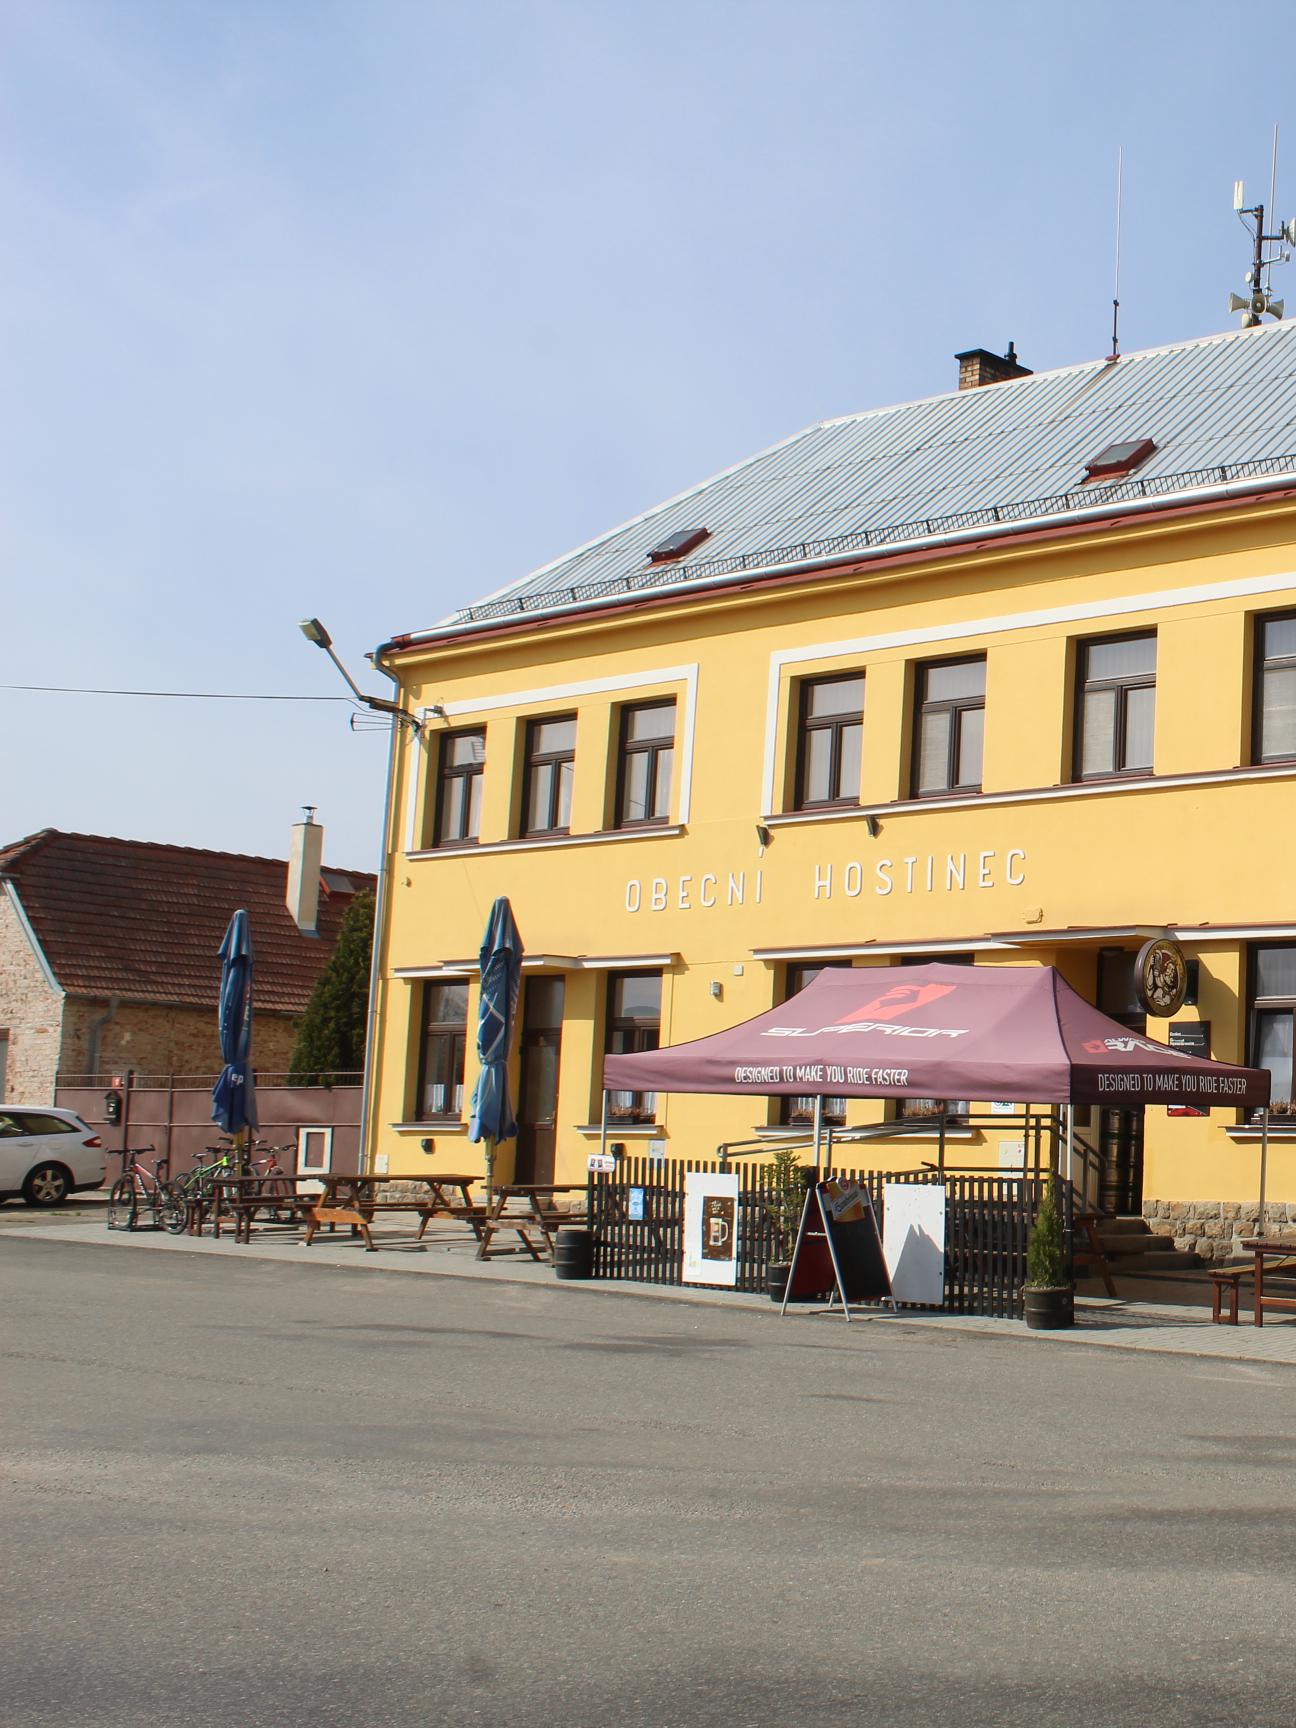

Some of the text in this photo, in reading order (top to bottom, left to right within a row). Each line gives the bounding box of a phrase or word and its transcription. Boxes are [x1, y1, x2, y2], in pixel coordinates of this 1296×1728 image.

[625, 847, 1025, 912] OBECNÍ HOSTINEC
[760, 1022, 969, 1038] SUPERIOR
[735, 1065, 908, 1086] DESIGNED TO MAKE YOU RIDE FASTER
[1098, 1074, 1247, 1095] DESIGNED TO MAKE YOU RIDE FASTER
